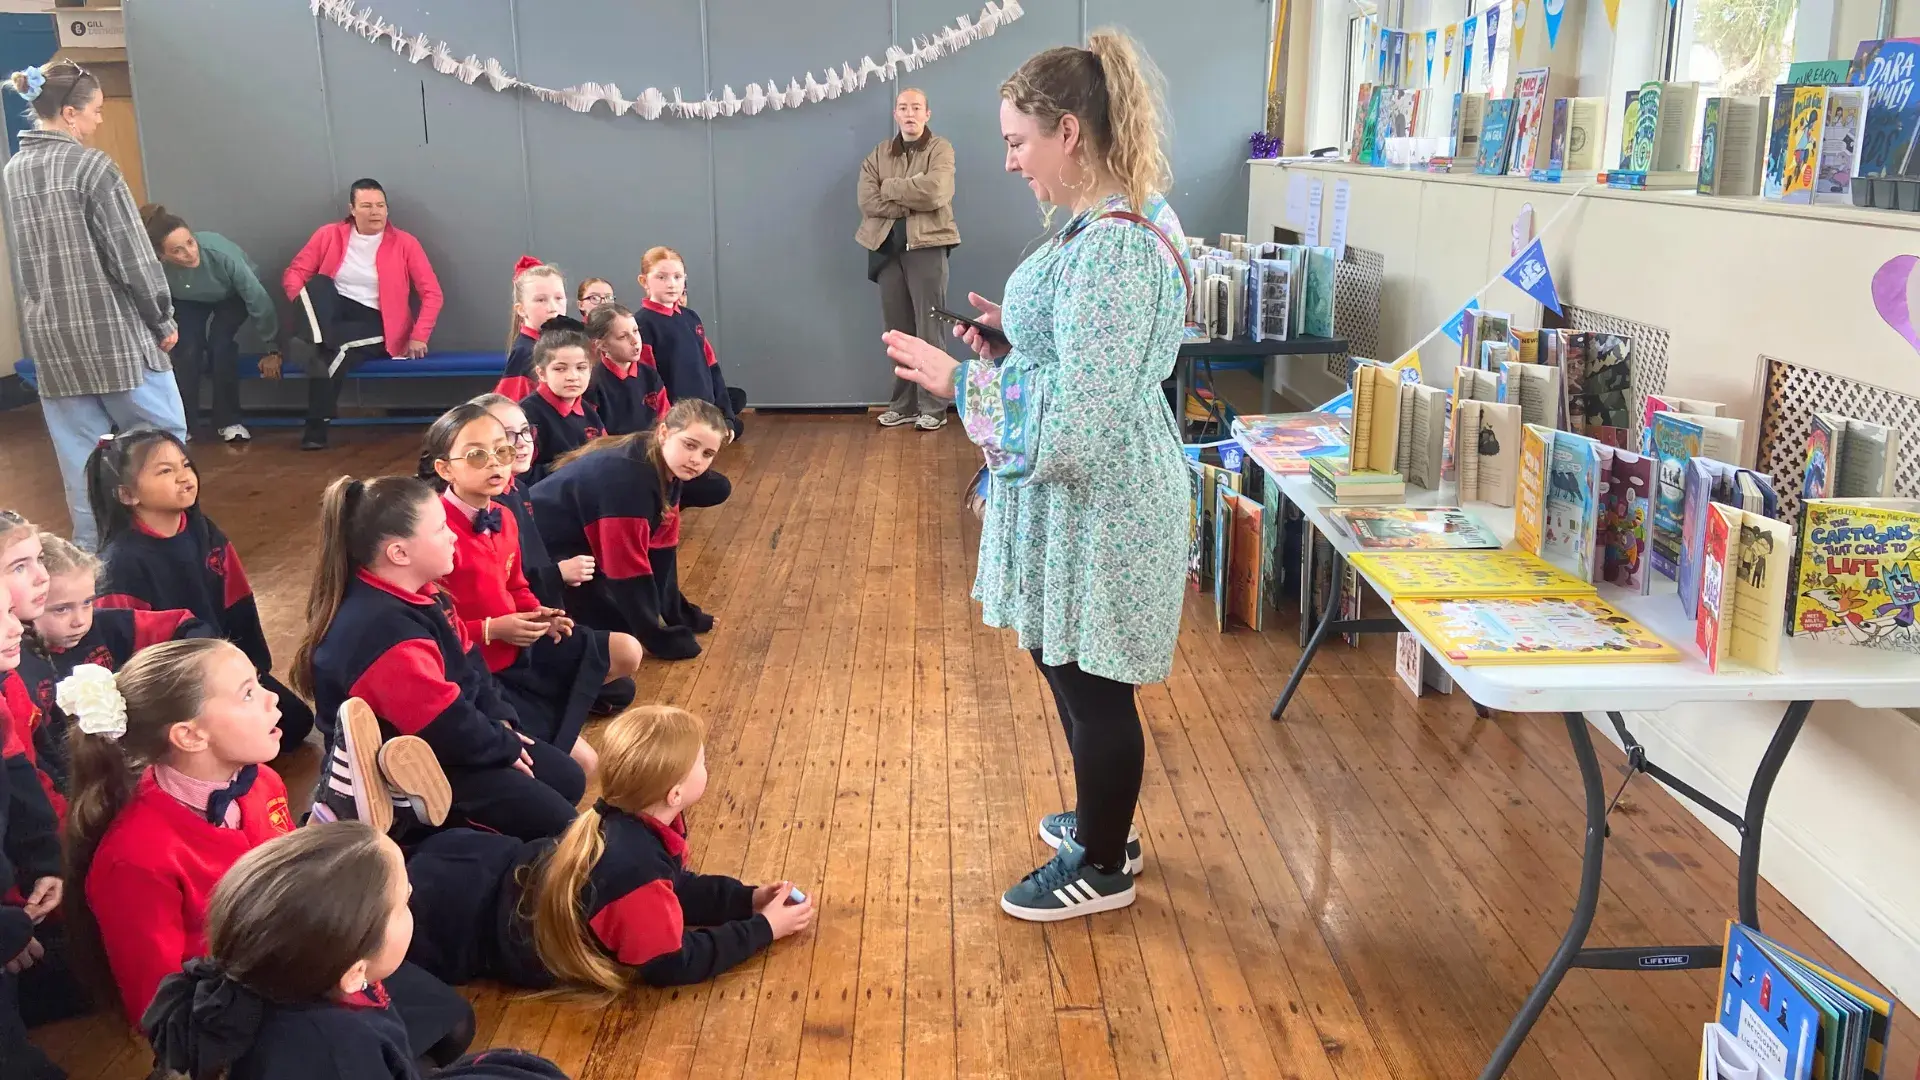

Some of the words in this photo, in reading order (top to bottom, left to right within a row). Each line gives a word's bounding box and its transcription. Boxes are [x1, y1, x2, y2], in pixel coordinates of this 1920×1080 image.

[87, 20, 104, 28] GILL
[1867, 78, 1915, 113] ANULTY
[1825, 506, 1836, 514] TOM
[1837, 508, 1858, 517] ELLEN
[1830, 518, 1849, 528] THE
[1811, 524, 1914, 545] CARTOONS
[1822, 543, 1852, 556] THAT
[1854, 543, 1889, 556] CAME
[1890, 542, 1907, 553] TO
[1826, 556, 1880, 578] LIFE
[1644, 956, 1683, 965] LIFETIME
